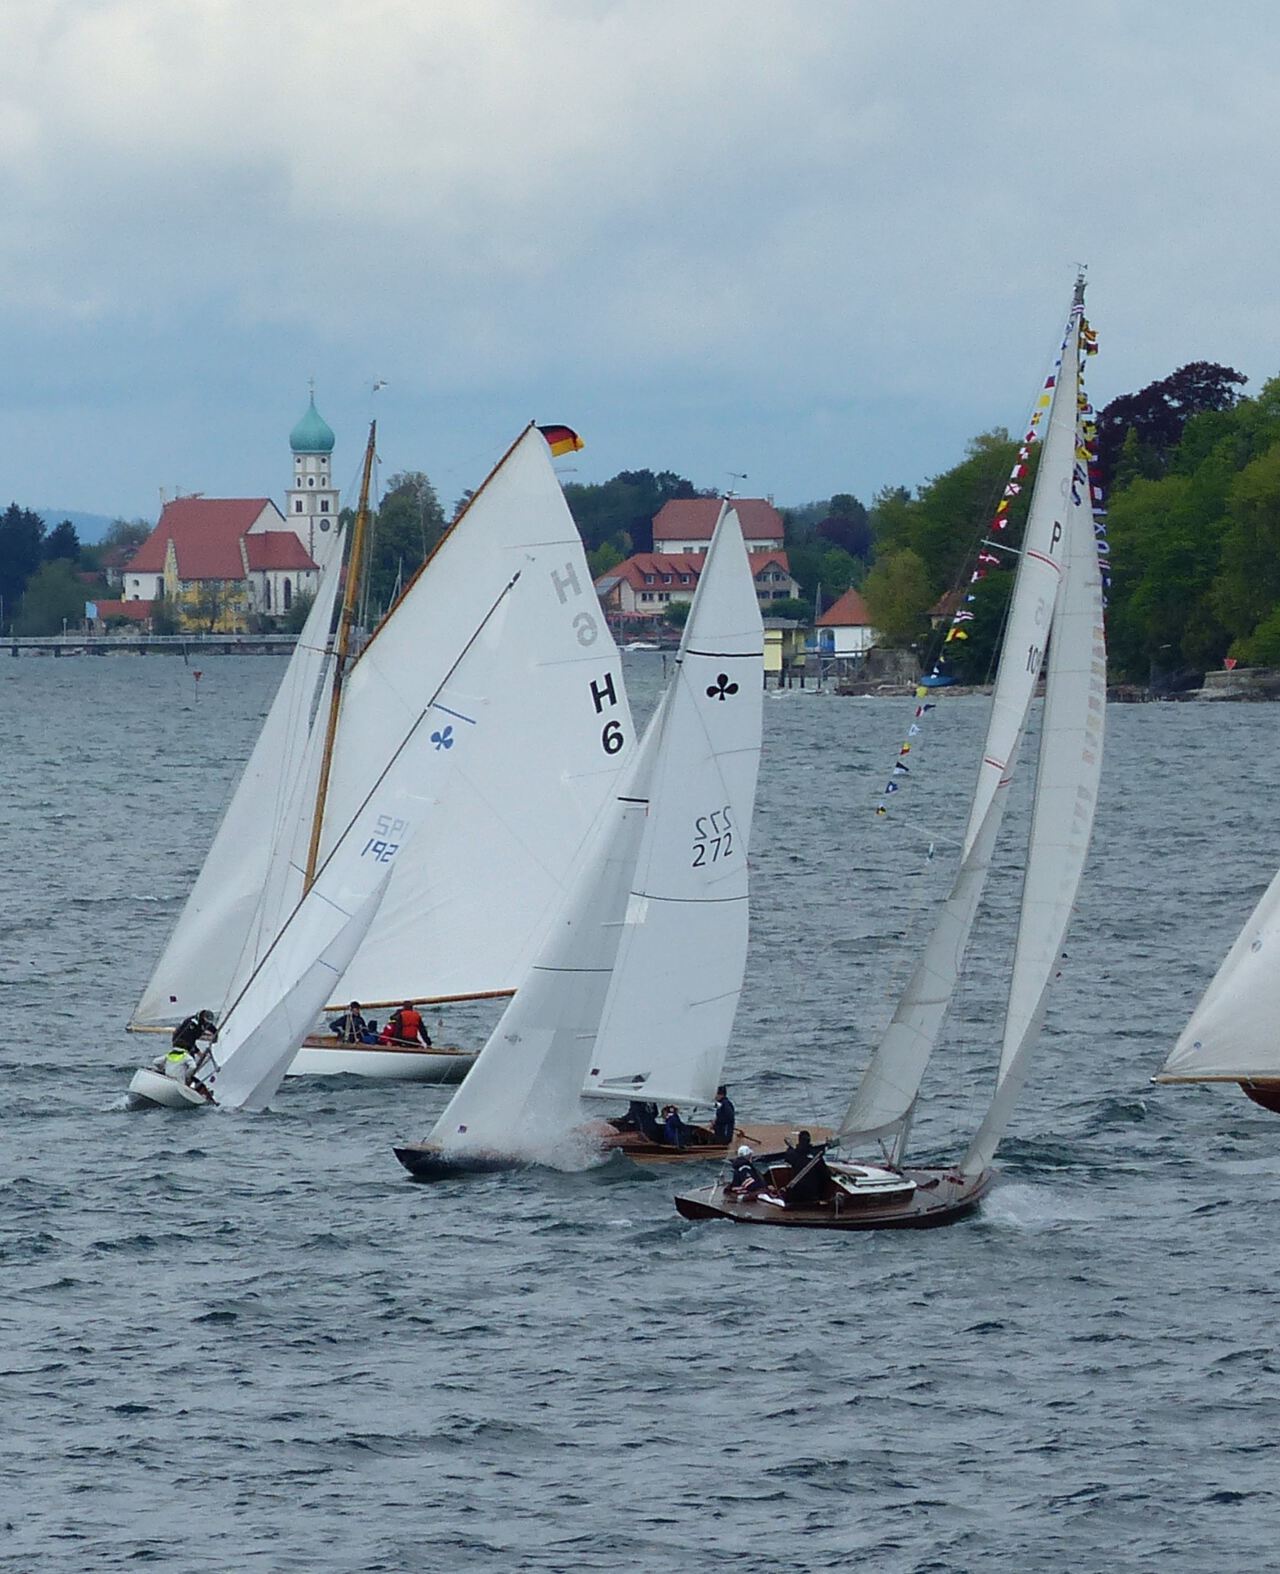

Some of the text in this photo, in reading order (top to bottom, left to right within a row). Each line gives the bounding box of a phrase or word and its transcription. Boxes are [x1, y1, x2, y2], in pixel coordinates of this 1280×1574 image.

[1049, 520, 1062, 554] P
[589, 672, 617, 714] H
[601, 720, 624, 755] 6
[360, 838, 400, 863] 192
[692, 832, 733, 868] 272
